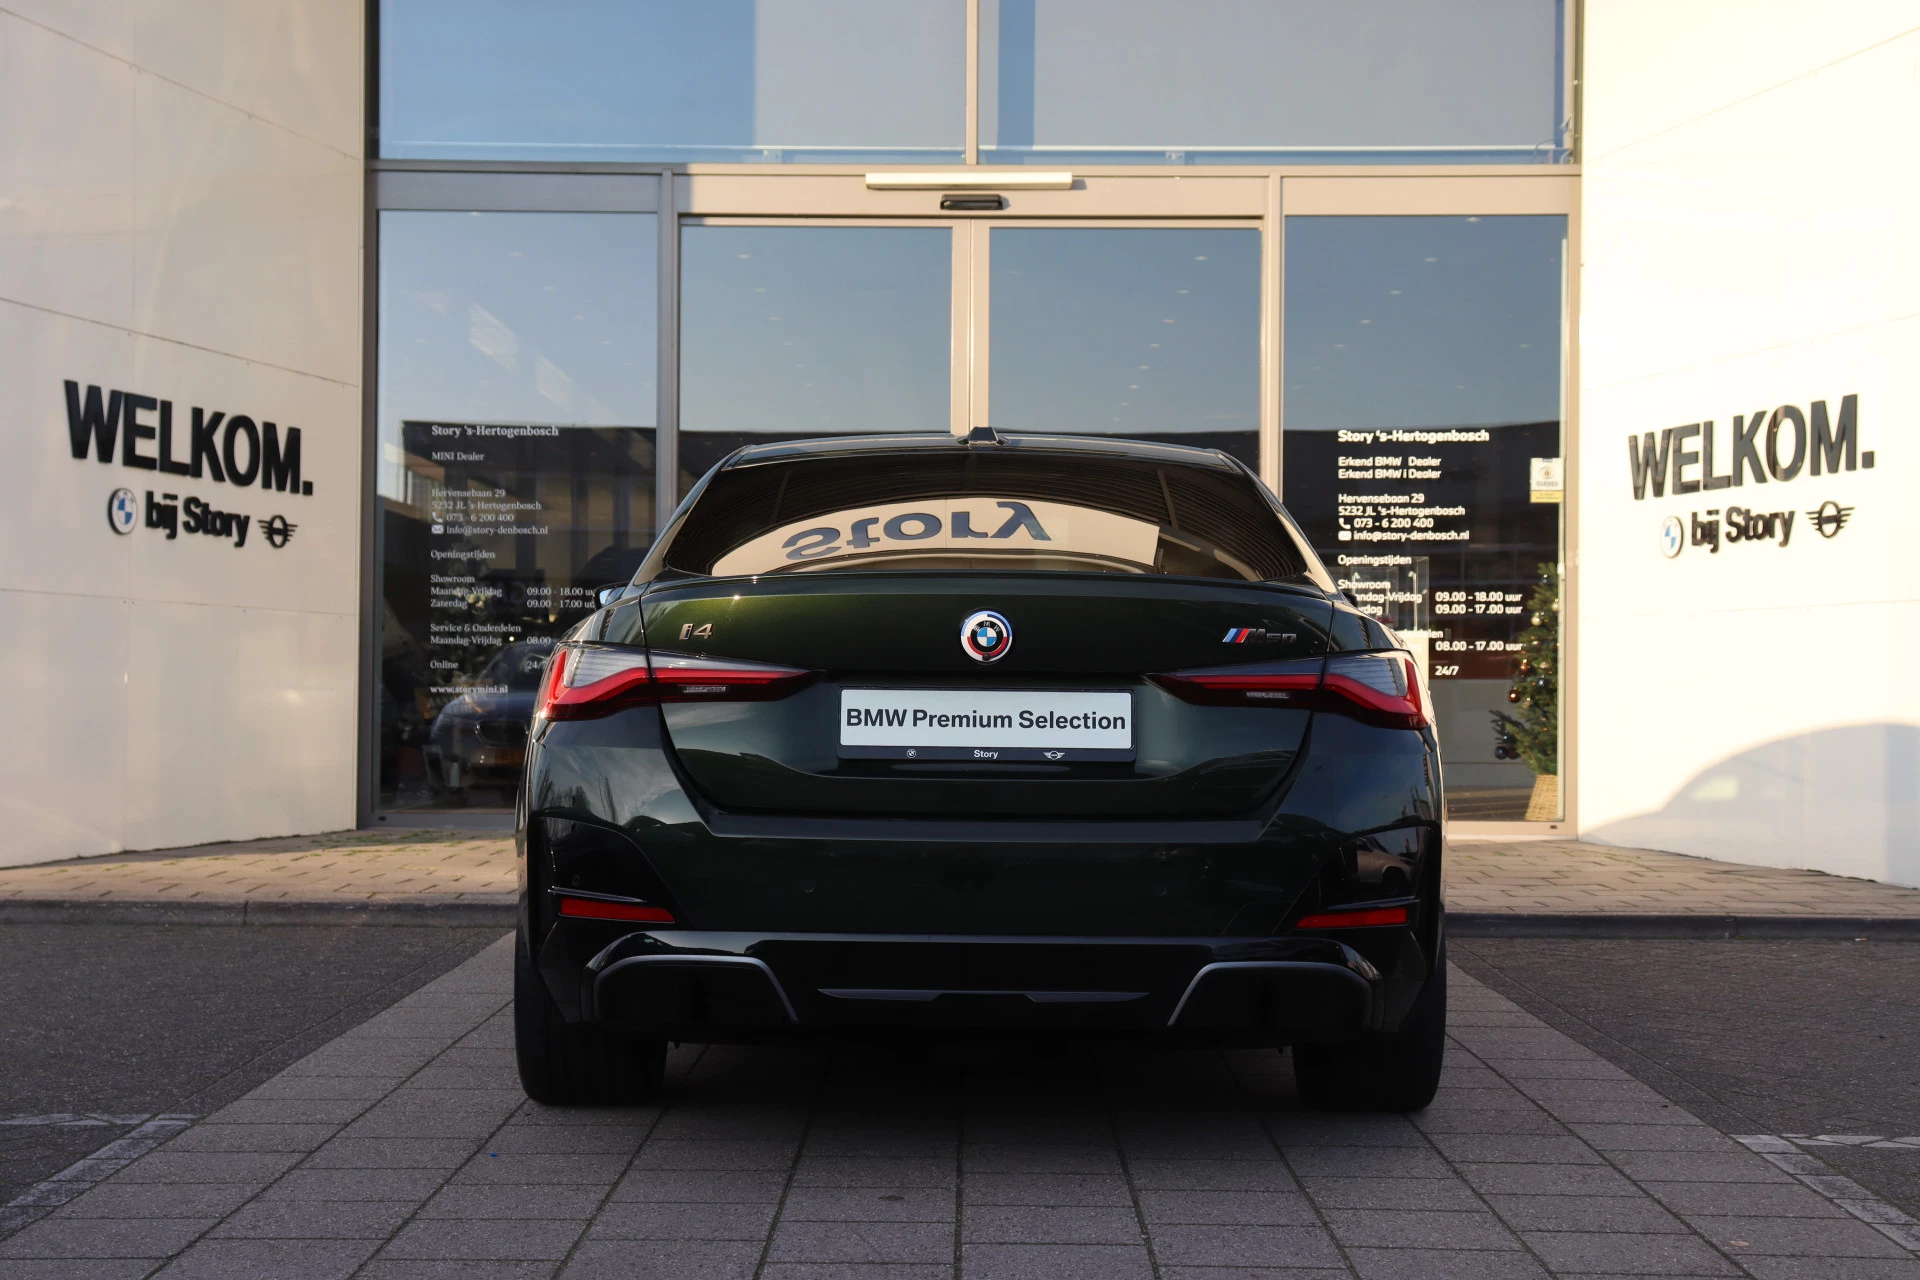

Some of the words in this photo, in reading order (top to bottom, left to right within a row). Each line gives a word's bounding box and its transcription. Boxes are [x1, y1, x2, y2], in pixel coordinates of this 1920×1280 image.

[431, 425, 461, 438] Story
[1338, 429, 1374, 444] Story
[64, 380, 313, 496] WELKOM.
[1628, 394, 1875, 500] WELKOM.
[432, 452, 454, 461] MINI
[456, 452, 484, 461] Dealer
[1338, 456, 1374, 466] Erkend
[1375, 456, 1402, 466] BMW
[1408, 456, 1442, 466] Dealer
[1338, 469, 1374, 479] Erkend
[1375, 469, 1402, 479] BMW
[1403, 469, 1407, 479] i
[1408, 469, 1442, 479] Dealer
[432, 489, 492, 498] Hervensebaan
[494, 489, 506, 498] 29
[1338, 494, 1409, 504] Hervensebaan
[1411, 494, 1425, 504] 29
[432, 501, 454, 510] 5232
[455, 501, 466, 510] JL
[1338, 506, 1363, 516] 5232
[1364, 506, 1376, 516] JL
[145, 490, 178, 540] bij
[182, 496, 250, 548] Story
[446, 513, 463, 522] 073
[471, 513, 476, 522] 6
[477, 513, 495, 522] 200
[497, 513, 514, 522] 400
[1353, 518, 1373, 528] 073
[1381, 518, 1388, 528] 6
[1390, 518, 1411, 528] 200
[1412, 518, 1434, 528] 400
[446, 525, 548, 536] info@story-denbosch.nl
[1691, 509, 1720, 553] bij
[1725, 506, 1795, 548] Story
[1353, 530, 1469, 542] info@story-denbosch.nl
[431, 550, 496, 561] Openingstijden
[1338, 555, 1412, 566] Openingstijden
[430, 574, 475, 583] Showroom
[1338, 579, 1391, 590] Showroom
[430, 587, 503, 598] Maandag-Vrijdag
[527, 587, 551, 596] 09.00
[559, 587, 582, 596] 18.00
[1435, 592, 1467, 602] 09.00
[1474, 592, 1504, 602] 18.00
[1505, 594, 1522, 602] uur
[430, 599, 468, 610] Zaterdag
[527, 599, 551, 608] 09.00
[559, 599, 582, 608] 17.00
[1435, 604, 1467, 614] 09.00
[1475, 604, 1504, 614] 17.00
[1505, 606, 1523, 614] uur
[430, 624, 462, 632] Service
[472, 624, 522, 633] Onderdelen
[679, 623, 713, 640] i4
[430, 636, 502, 647] Maandag-Vrijdag
[527, 636, 551, 645] 08.00
[1435, 641, 1467, 651] 08.00
[1475, 641, 1504, 651] 17.00
[1505, 643, 1523, 651] uur
[430, 660, 459, 669] Online
[1435, 666, 1459, 676] 24/7
[430, 685, 509, 694] www.storymini.nl
[846, 708, 908, 727] BMW
[912, 708, 1013, 729] Premium
[1018, 710, 1126, 730] Selection
[973, 750, 999, 760] Story
